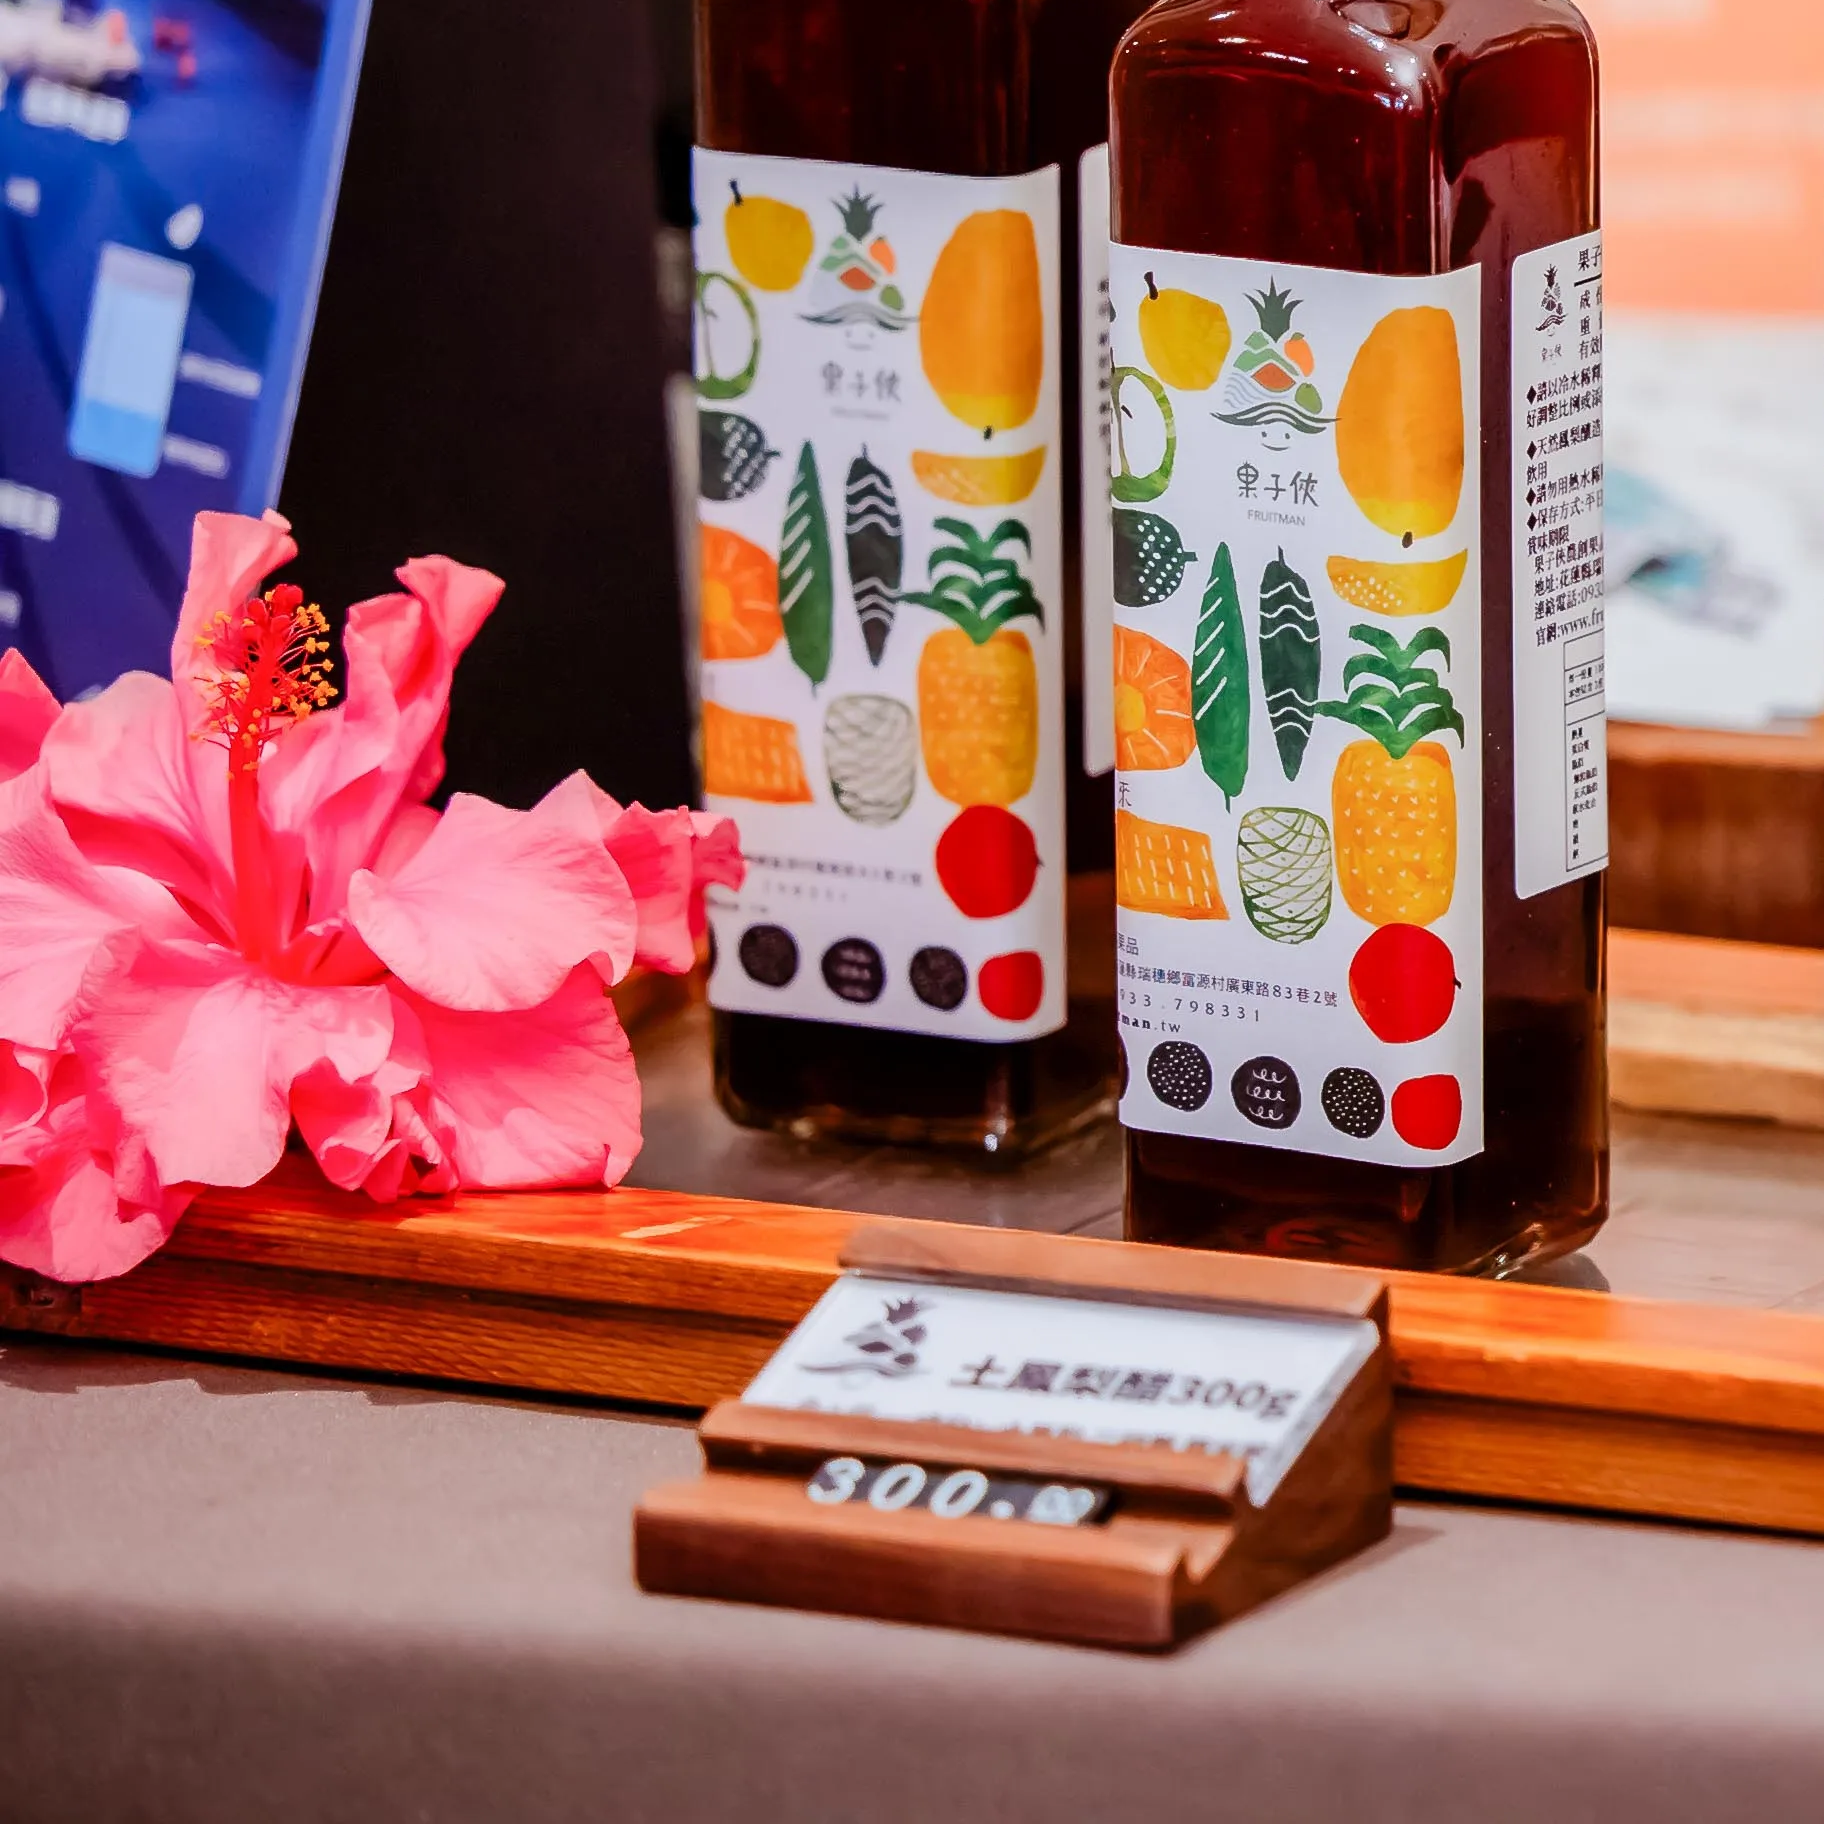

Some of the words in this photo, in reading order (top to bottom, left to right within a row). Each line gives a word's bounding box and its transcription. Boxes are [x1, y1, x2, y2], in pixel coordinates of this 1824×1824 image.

[1579, 336, 1602, 360] 有效
[1237, 461, 1319, 507] 果子俠
[1536, 463, 1603, 504] 請勿用熱水稀
[1247, 509, 1305, 526] FRUITMAN
[1534, 556, 1603, 596] 地址:花蓮縣瑞
[948, 1354, 1298, 1420] 土鳳梨醋300g
